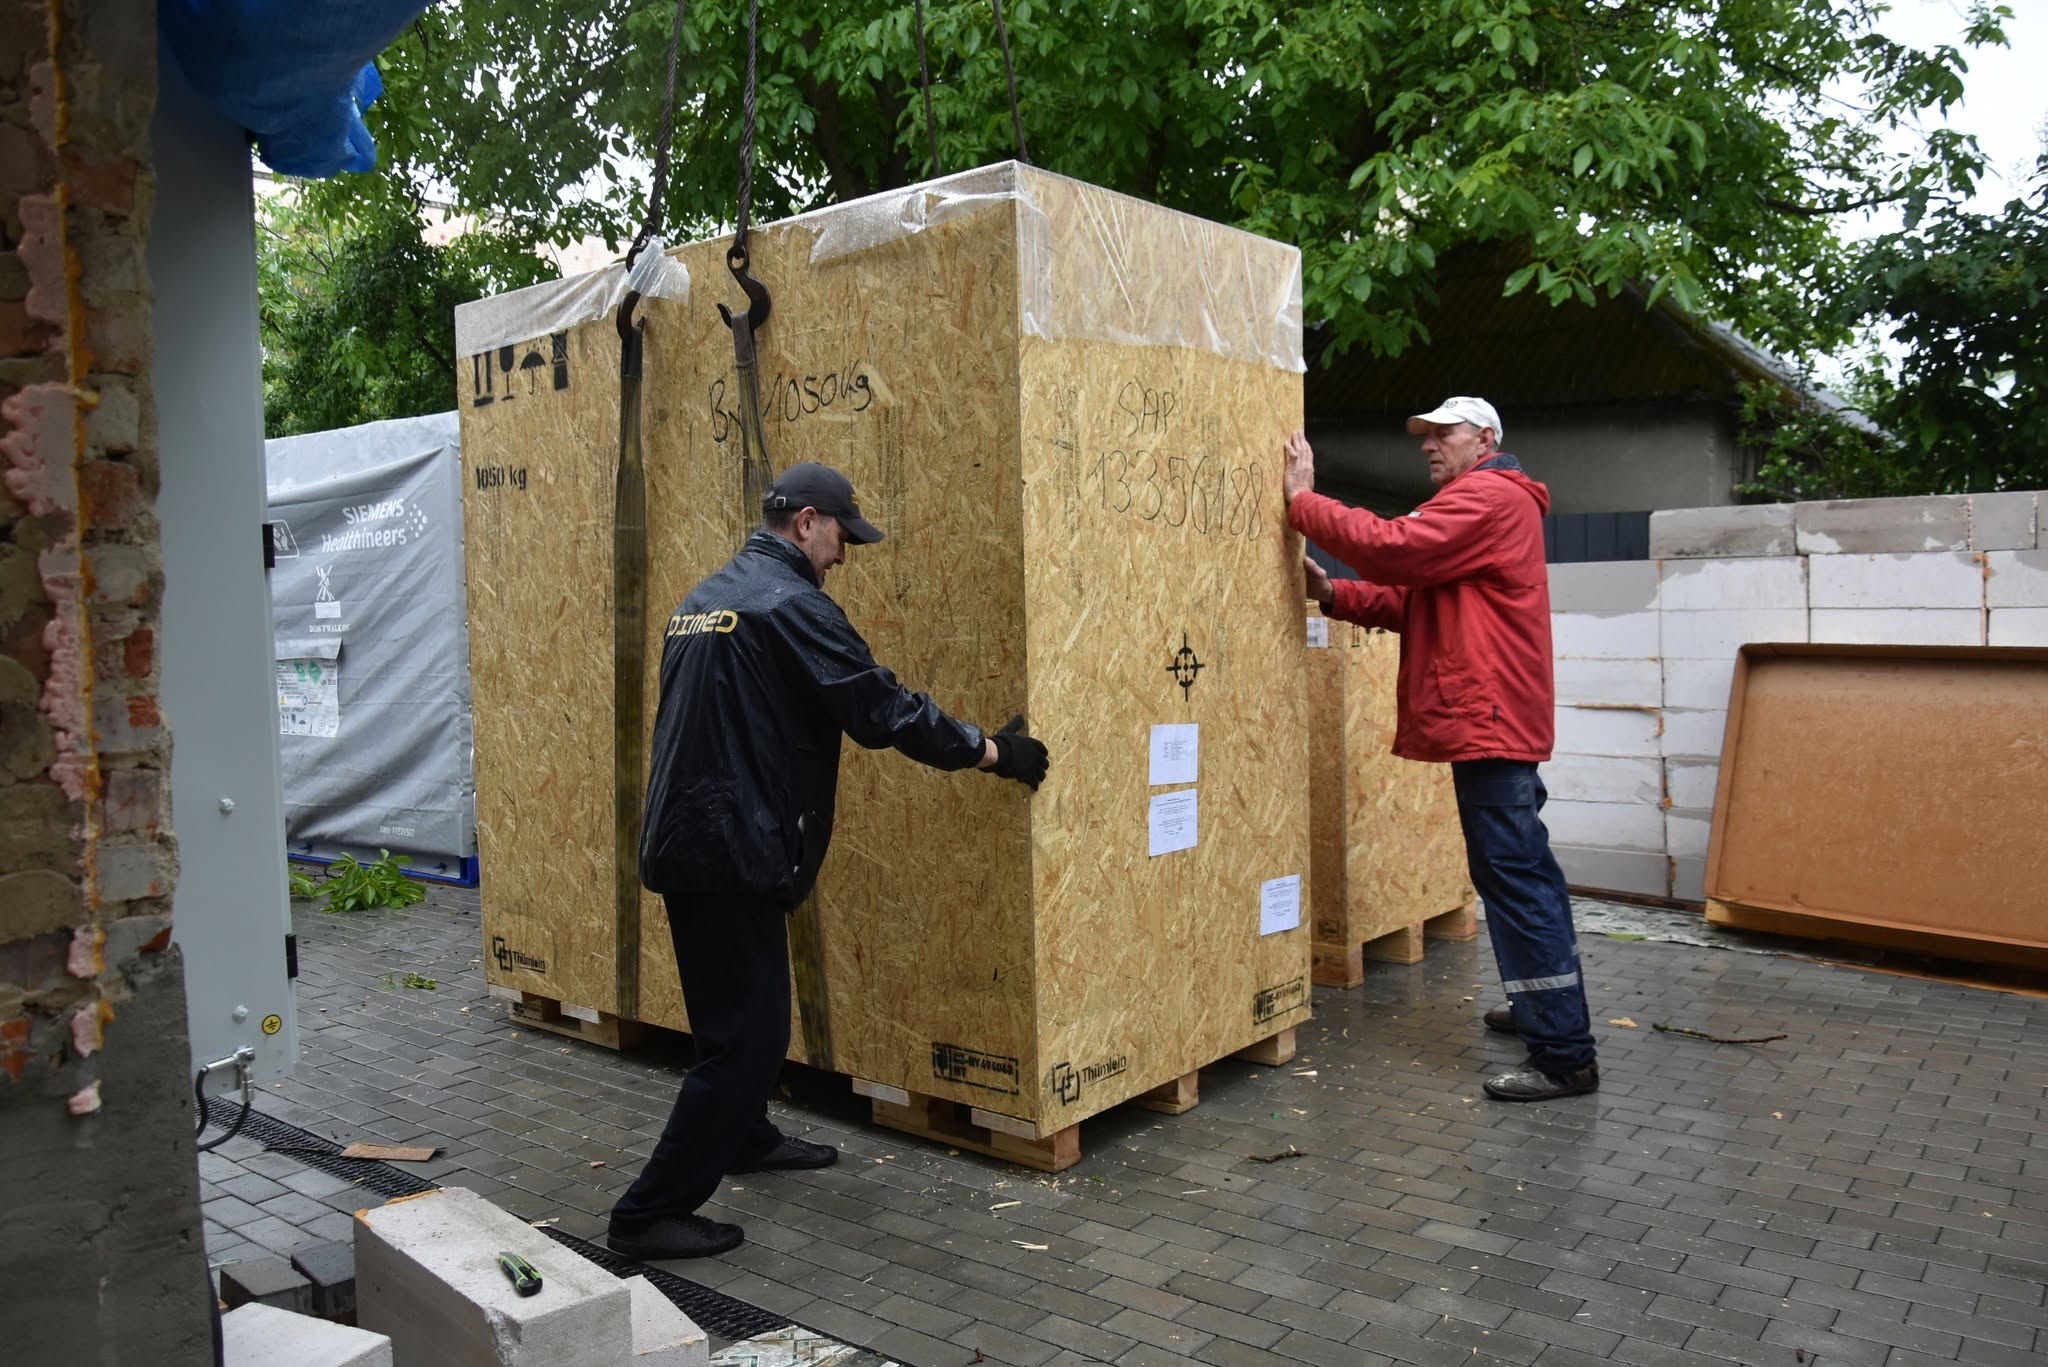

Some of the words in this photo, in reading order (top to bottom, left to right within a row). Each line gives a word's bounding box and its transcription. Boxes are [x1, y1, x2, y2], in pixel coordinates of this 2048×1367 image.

[1118, 376, 1175, 438] SAP
[476, 465, 504, 490] 1050
[509, 463, 527, 490] kg
[1089, 450, 1264, 541] 13356188
[342, 498, 405, 525] SIEMENS
[321, 526, 407, 553] Healthineers
[667, 610, 738, 636] DIMED
